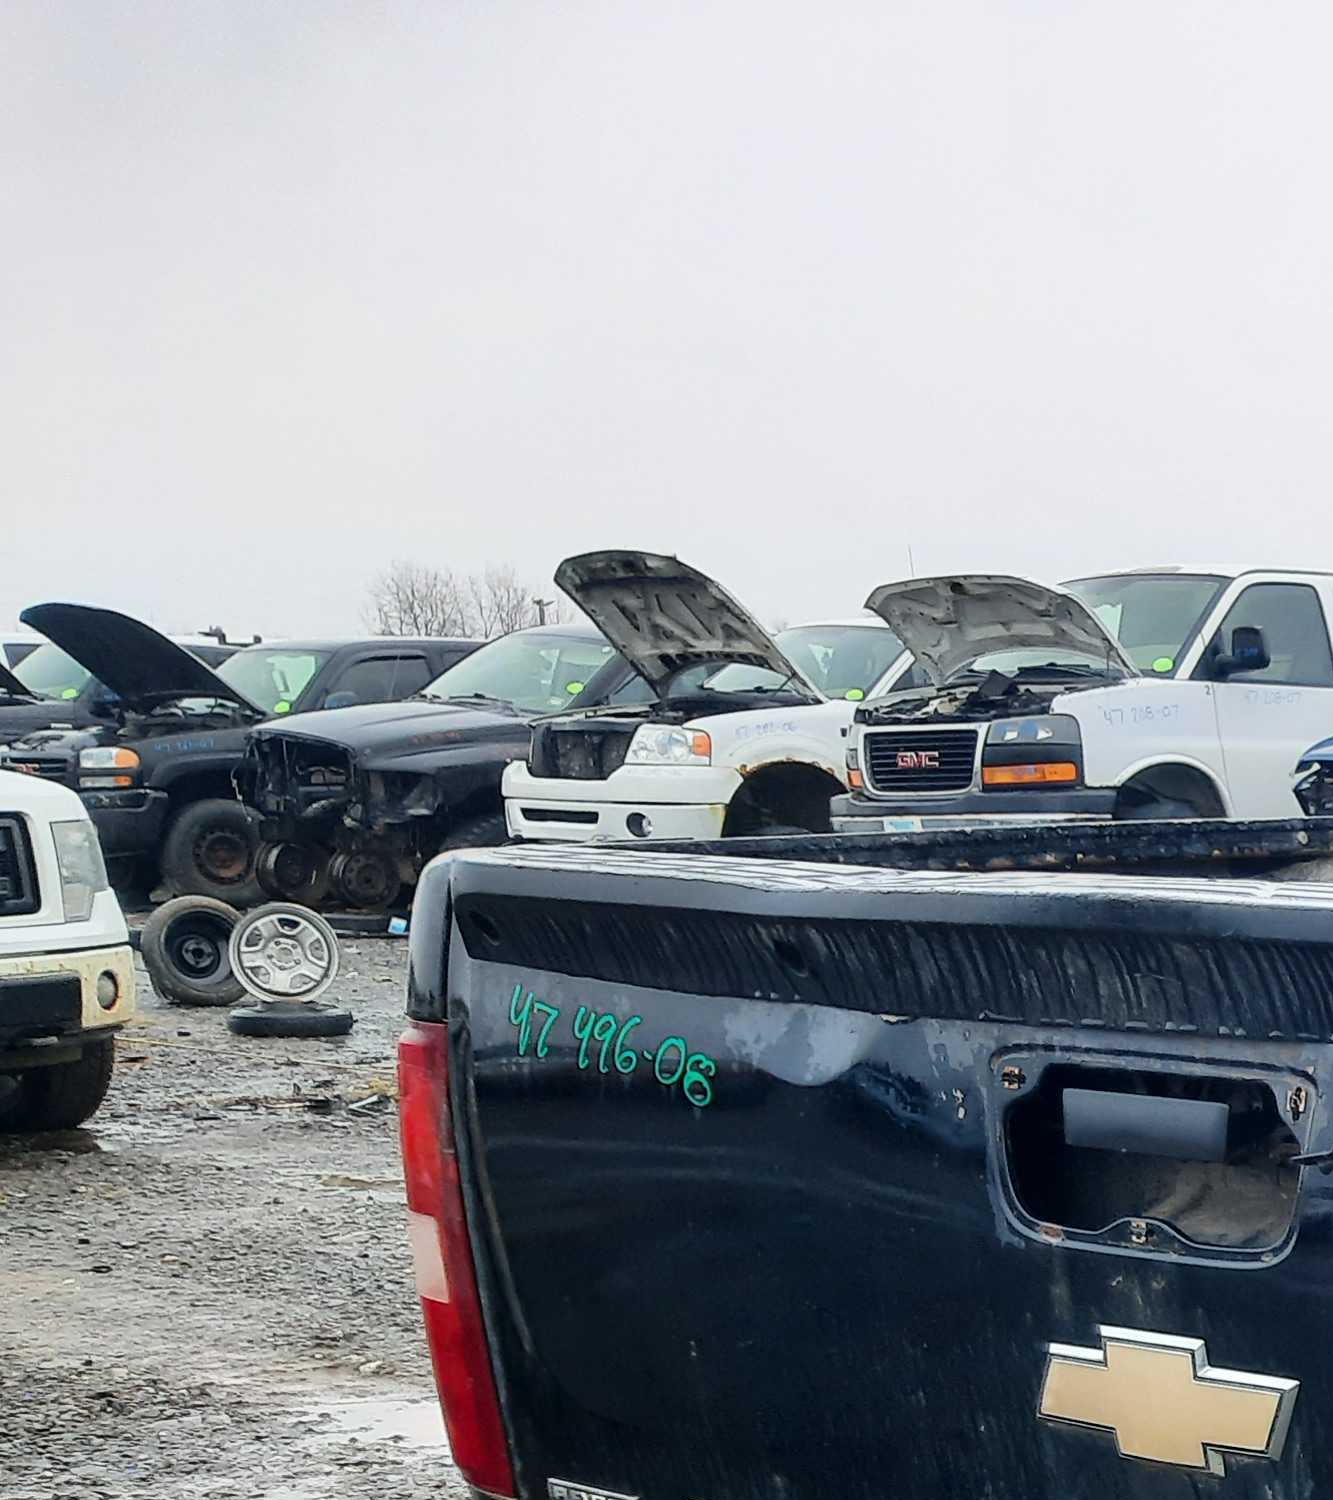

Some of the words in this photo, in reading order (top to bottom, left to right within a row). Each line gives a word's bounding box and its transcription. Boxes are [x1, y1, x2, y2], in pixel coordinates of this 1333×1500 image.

[896, 751, 940, 768] GMC
[509, 983, 560, 1058] 47
[573, 1005, 716, 1107] 496-08
